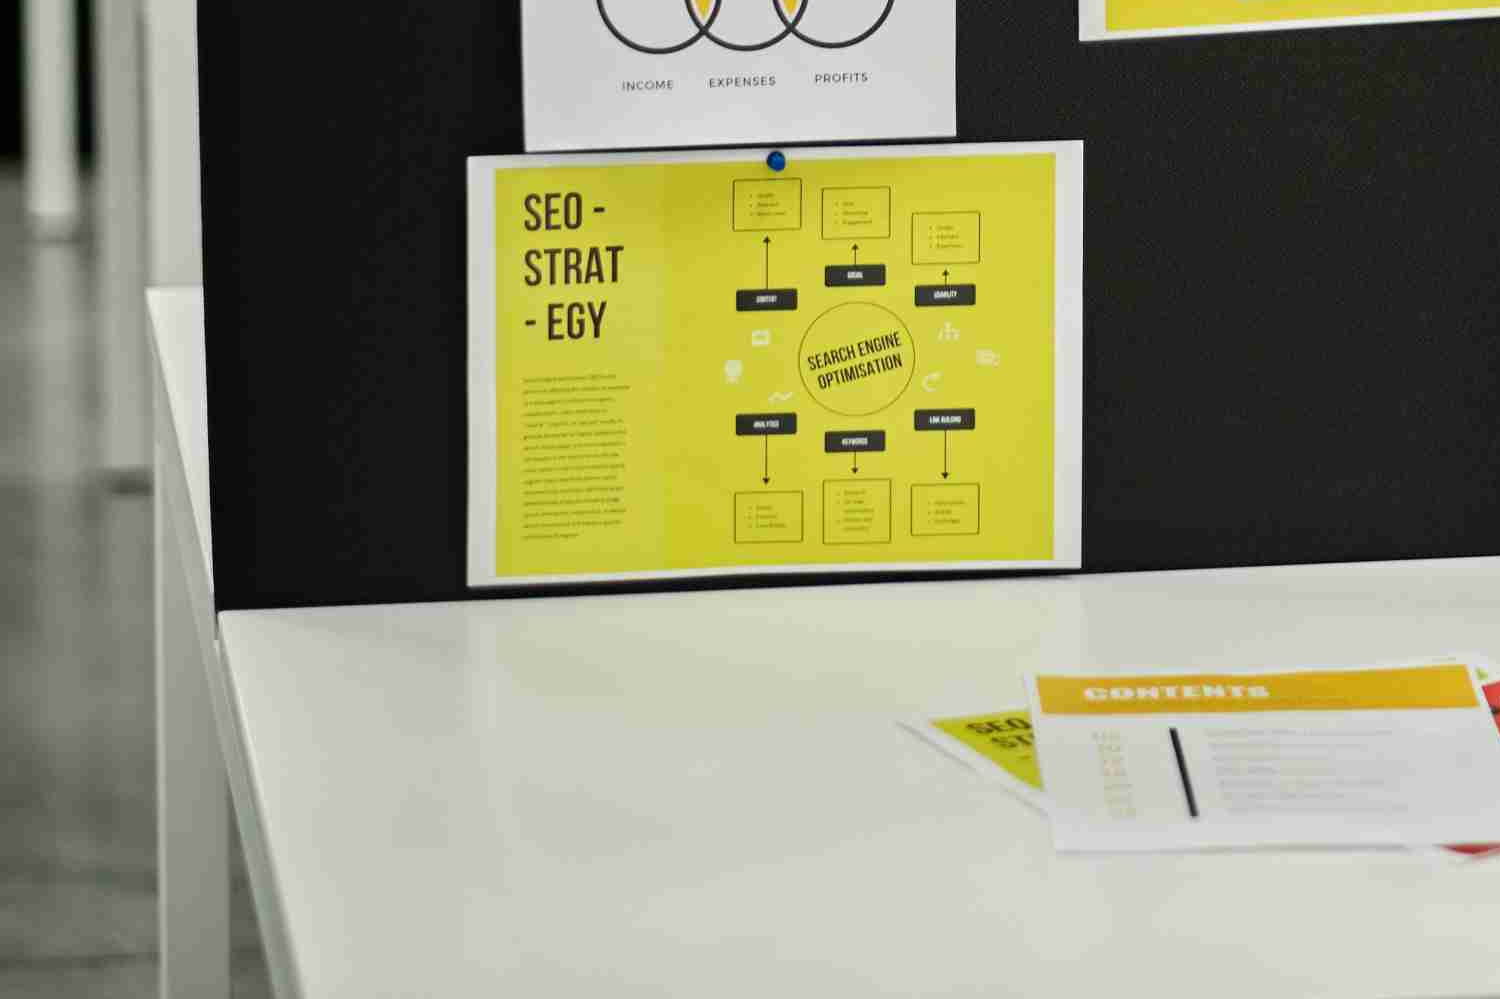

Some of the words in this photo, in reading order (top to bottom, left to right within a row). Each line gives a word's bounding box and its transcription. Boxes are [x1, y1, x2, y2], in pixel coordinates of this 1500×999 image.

[621, 79, 674, 92] INCOME
[708, 75, 777, 89] EXPENSES
[814, 72, 868, 84] PROFITS
[524, 192, 583, 232] SEO
[523, 245, 624, 287] STRAT
[547, 301, 608, 341] EGY
[807, 344, 856, 371] SEARCH
[857, 331, 901, 357] ENGINE
[817, 352, 903, 390] OPTIMISATION
[1084, 684, 1269, 700] CONTENTS
